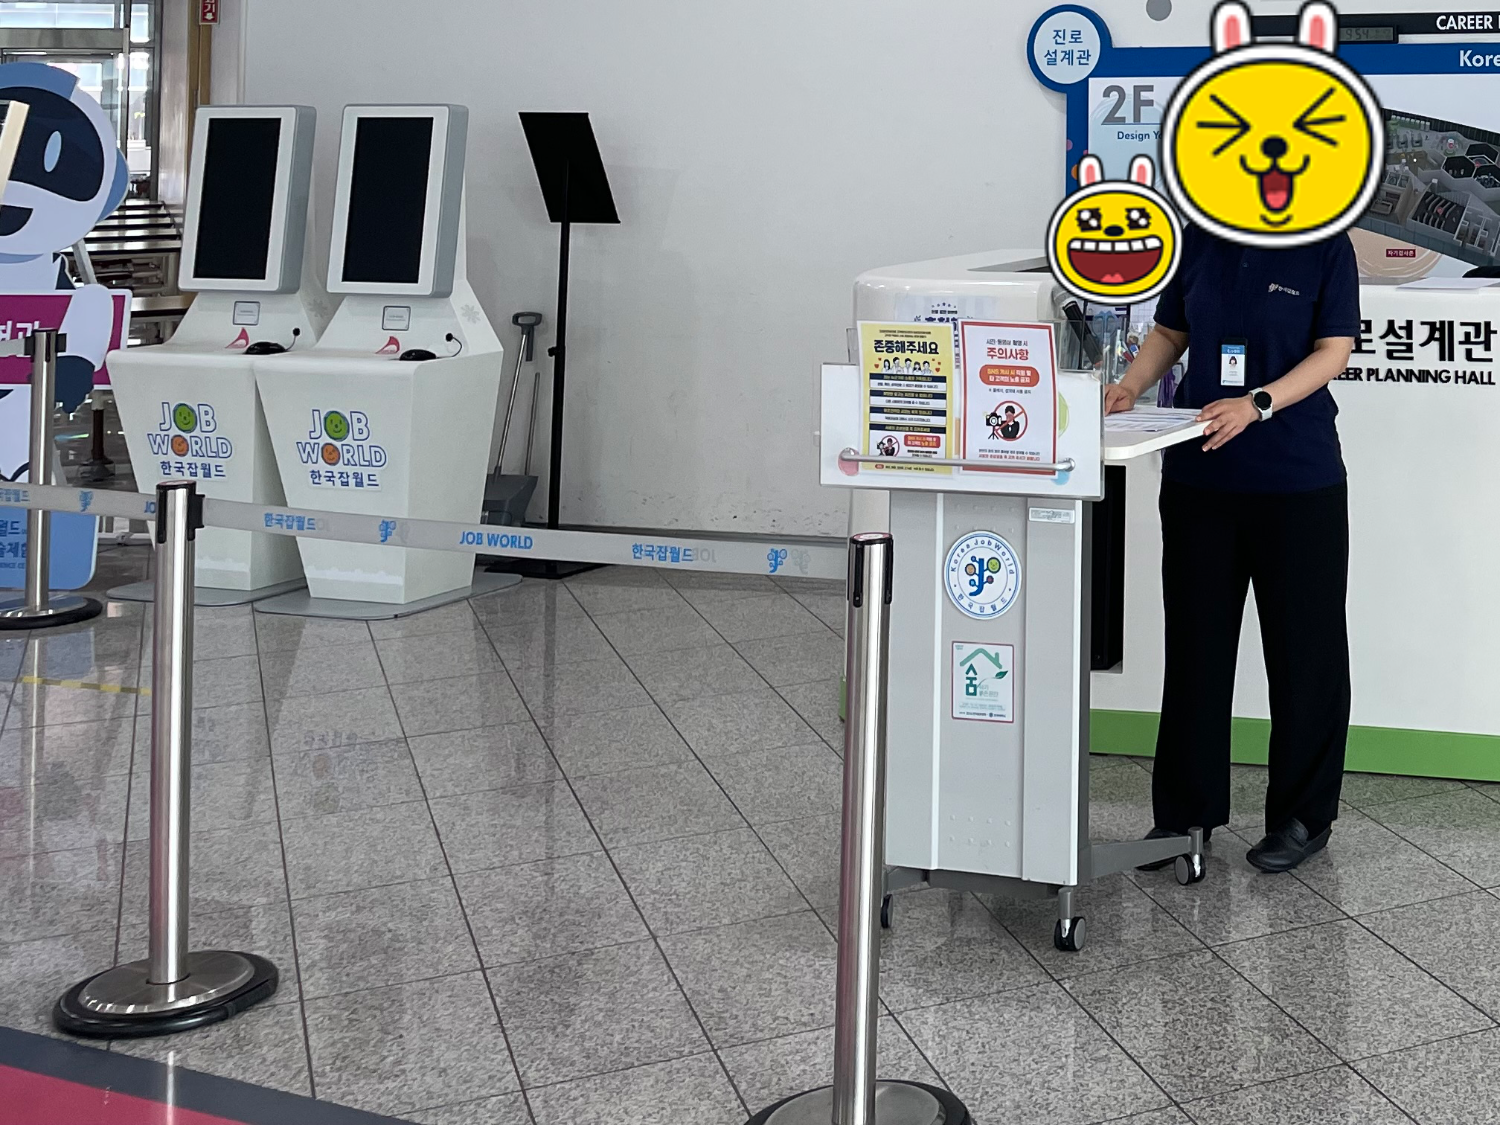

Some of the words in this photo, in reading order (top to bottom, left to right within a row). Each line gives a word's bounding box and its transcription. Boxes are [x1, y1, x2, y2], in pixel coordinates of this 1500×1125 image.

[1436, 15, 1493, 30] CAREER
[1052, 29, 1083, 45] 진로
[1044, 49, 1091, 66] 설계관
[1102, 85, 1155, 124] 2F
[1117, 130, 1150, 142] Design
[874, 339, 939, 355] 존중해주세요
[1351, 319, 1498, 362] 로설계관
[987, 347, 1029, 360] 주의사항
[1366, 368, 1451, 383] PLANNING
[1455, 370, 1495, 385] HALL
[159, 402, 217, 434] JOB
[309, 409, 370, 442] JOB
[147, 434, 233, 458] WORLD
[296, 442, 387, 468] WORLD
[160, 461, 226, 479] 한국잡월드
[309, 470, 380, 488] 한국잡월드
[264, 512, 316, 531] 한국잡월드
[460, 531, 483, 545] JOB
[487, 533, 533, 549] WORLD
[632, 543, 694, 563] 한국잡월드
[951, 544, 970, 573] Korea
[957, 593, 1008, 613] 한국잡월드
